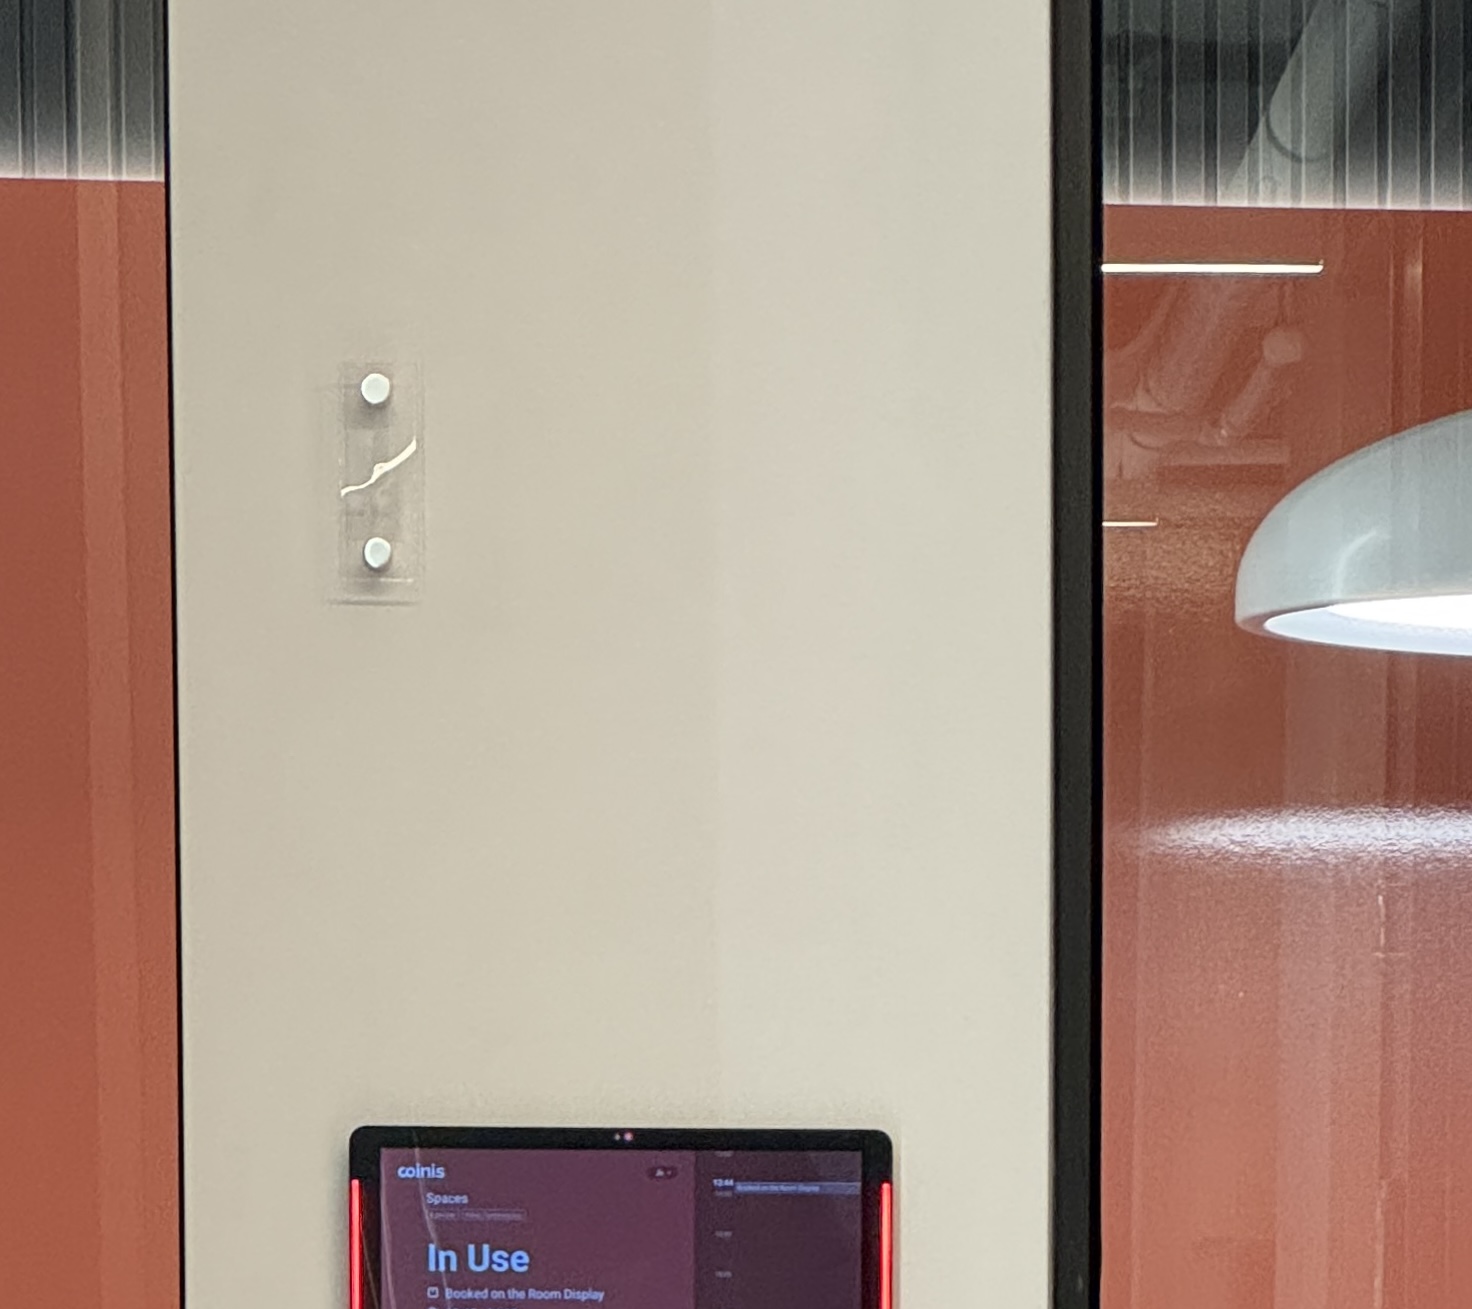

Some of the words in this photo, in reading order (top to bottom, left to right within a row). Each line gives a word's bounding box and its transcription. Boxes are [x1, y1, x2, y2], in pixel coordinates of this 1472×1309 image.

[397, 1162, 445, 1179] coinis
[426, 1192, 469, 1205] Spaces
[427, 1243, 458, 1273] In
[467, 1243, 530, 1273] Use
[445, 1287, 488, 1300] Booked
[490, 1290, 506, 1300] on
[508, 1288, 526, 1300] the
[528, 1288, 561, 1300] Room
[563, 1287, 605, 1302] Display
